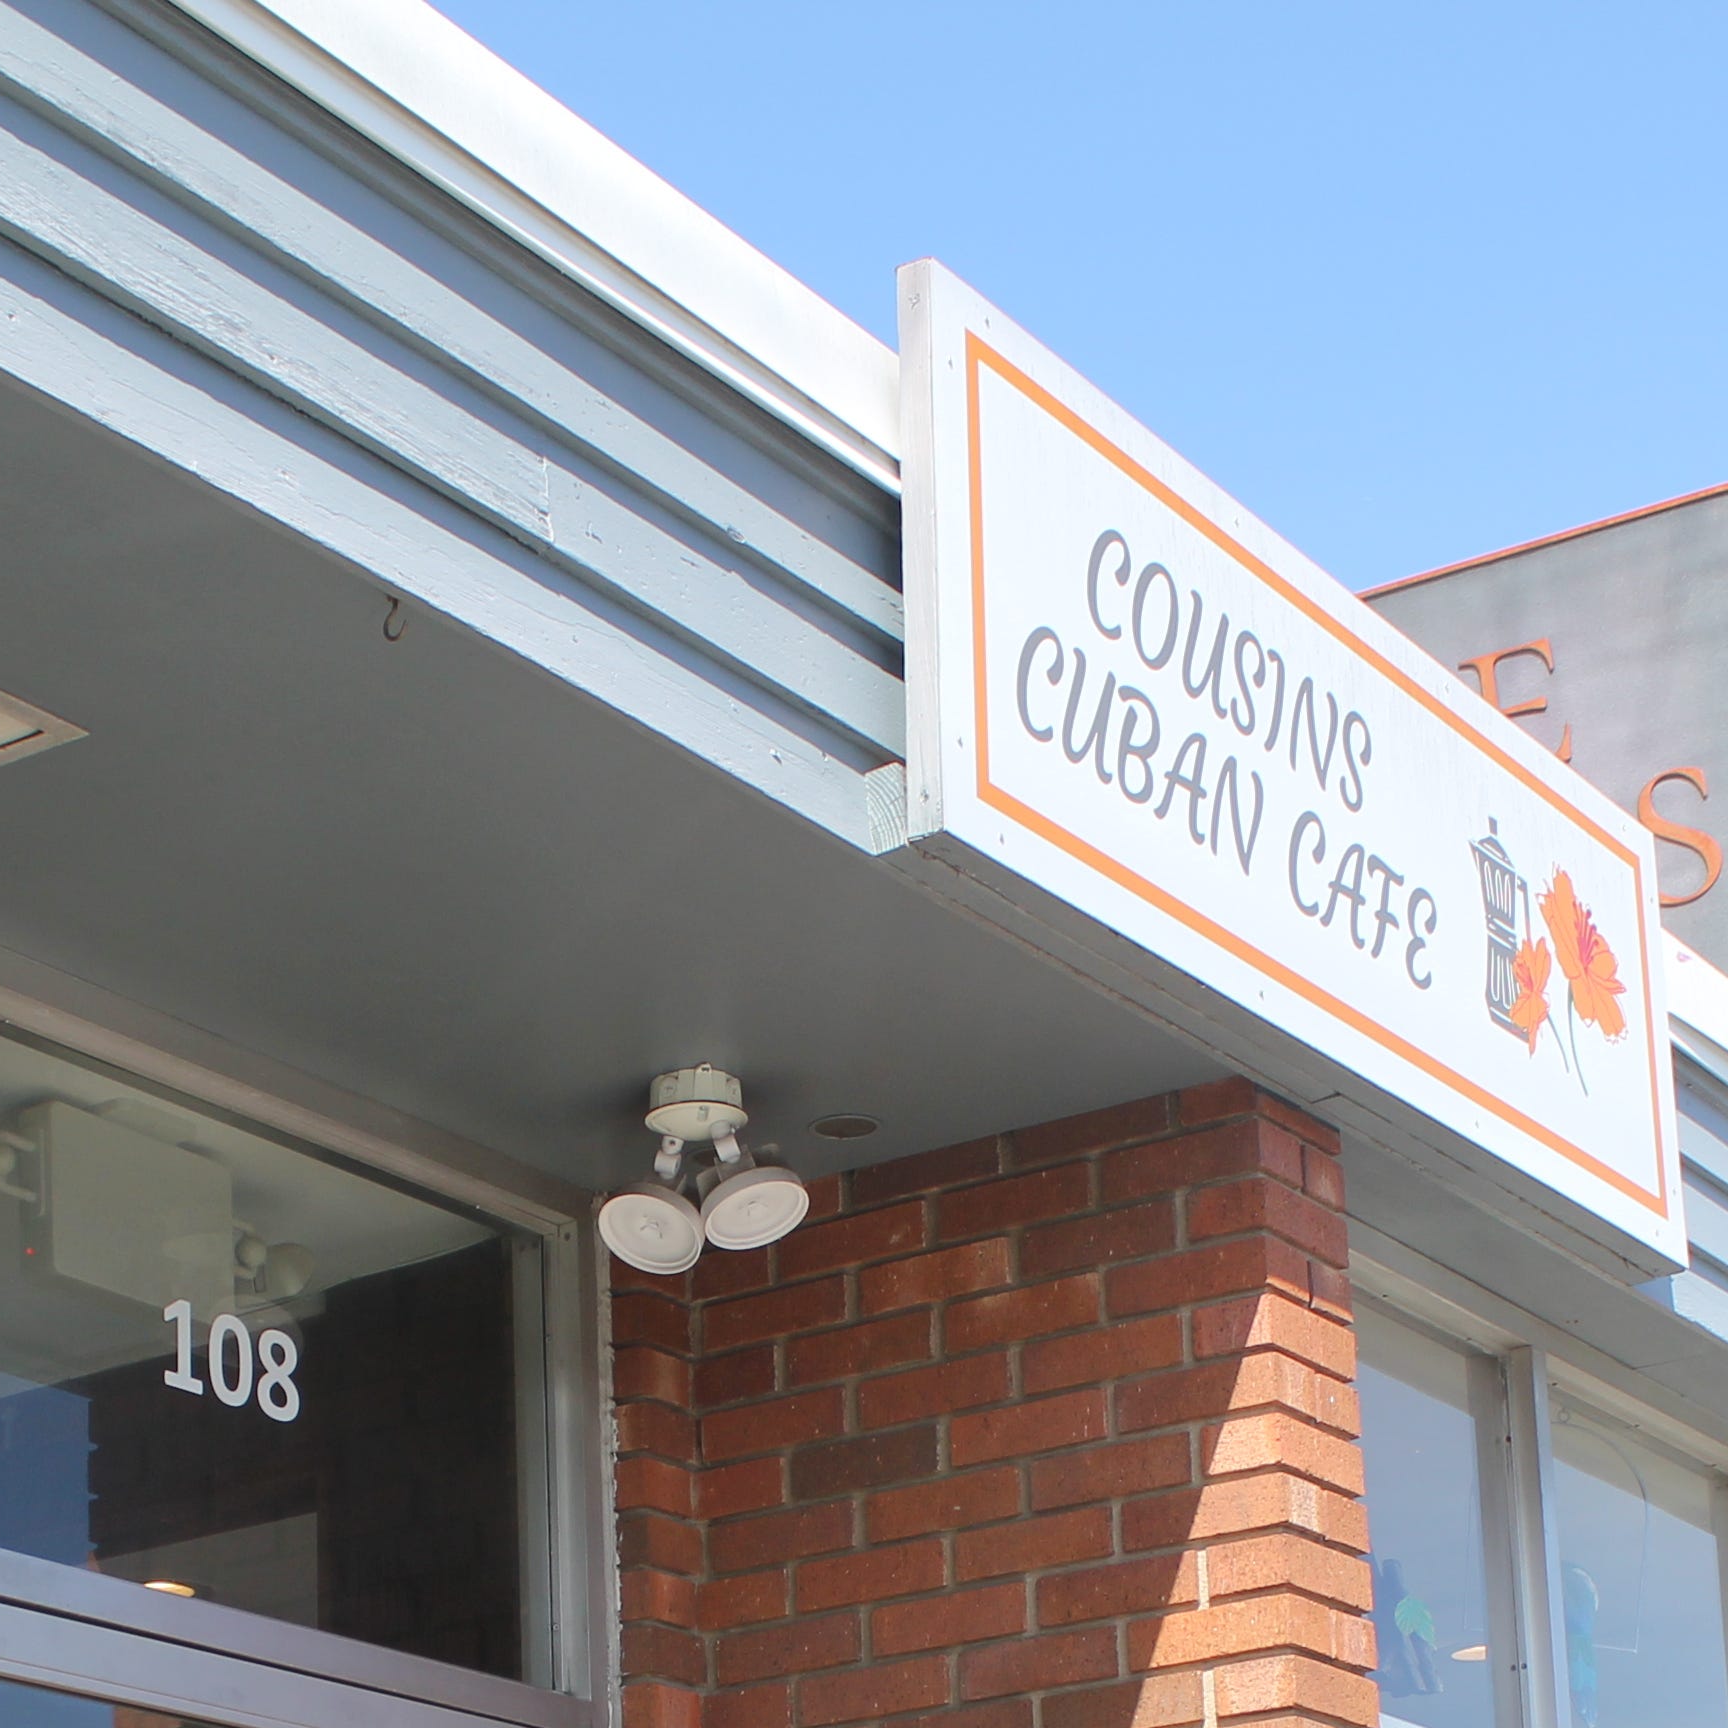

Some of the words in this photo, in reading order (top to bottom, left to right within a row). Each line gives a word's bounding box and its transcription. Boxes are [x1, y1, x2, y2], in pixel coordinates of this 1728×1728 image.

[1016, 625, 1265, 878] CUBAN
[1288, 808, 1437, 991] CAFE
[1086, 527, 1372, 813] COUSINS
[162, 1299, 300, 1422] 108
